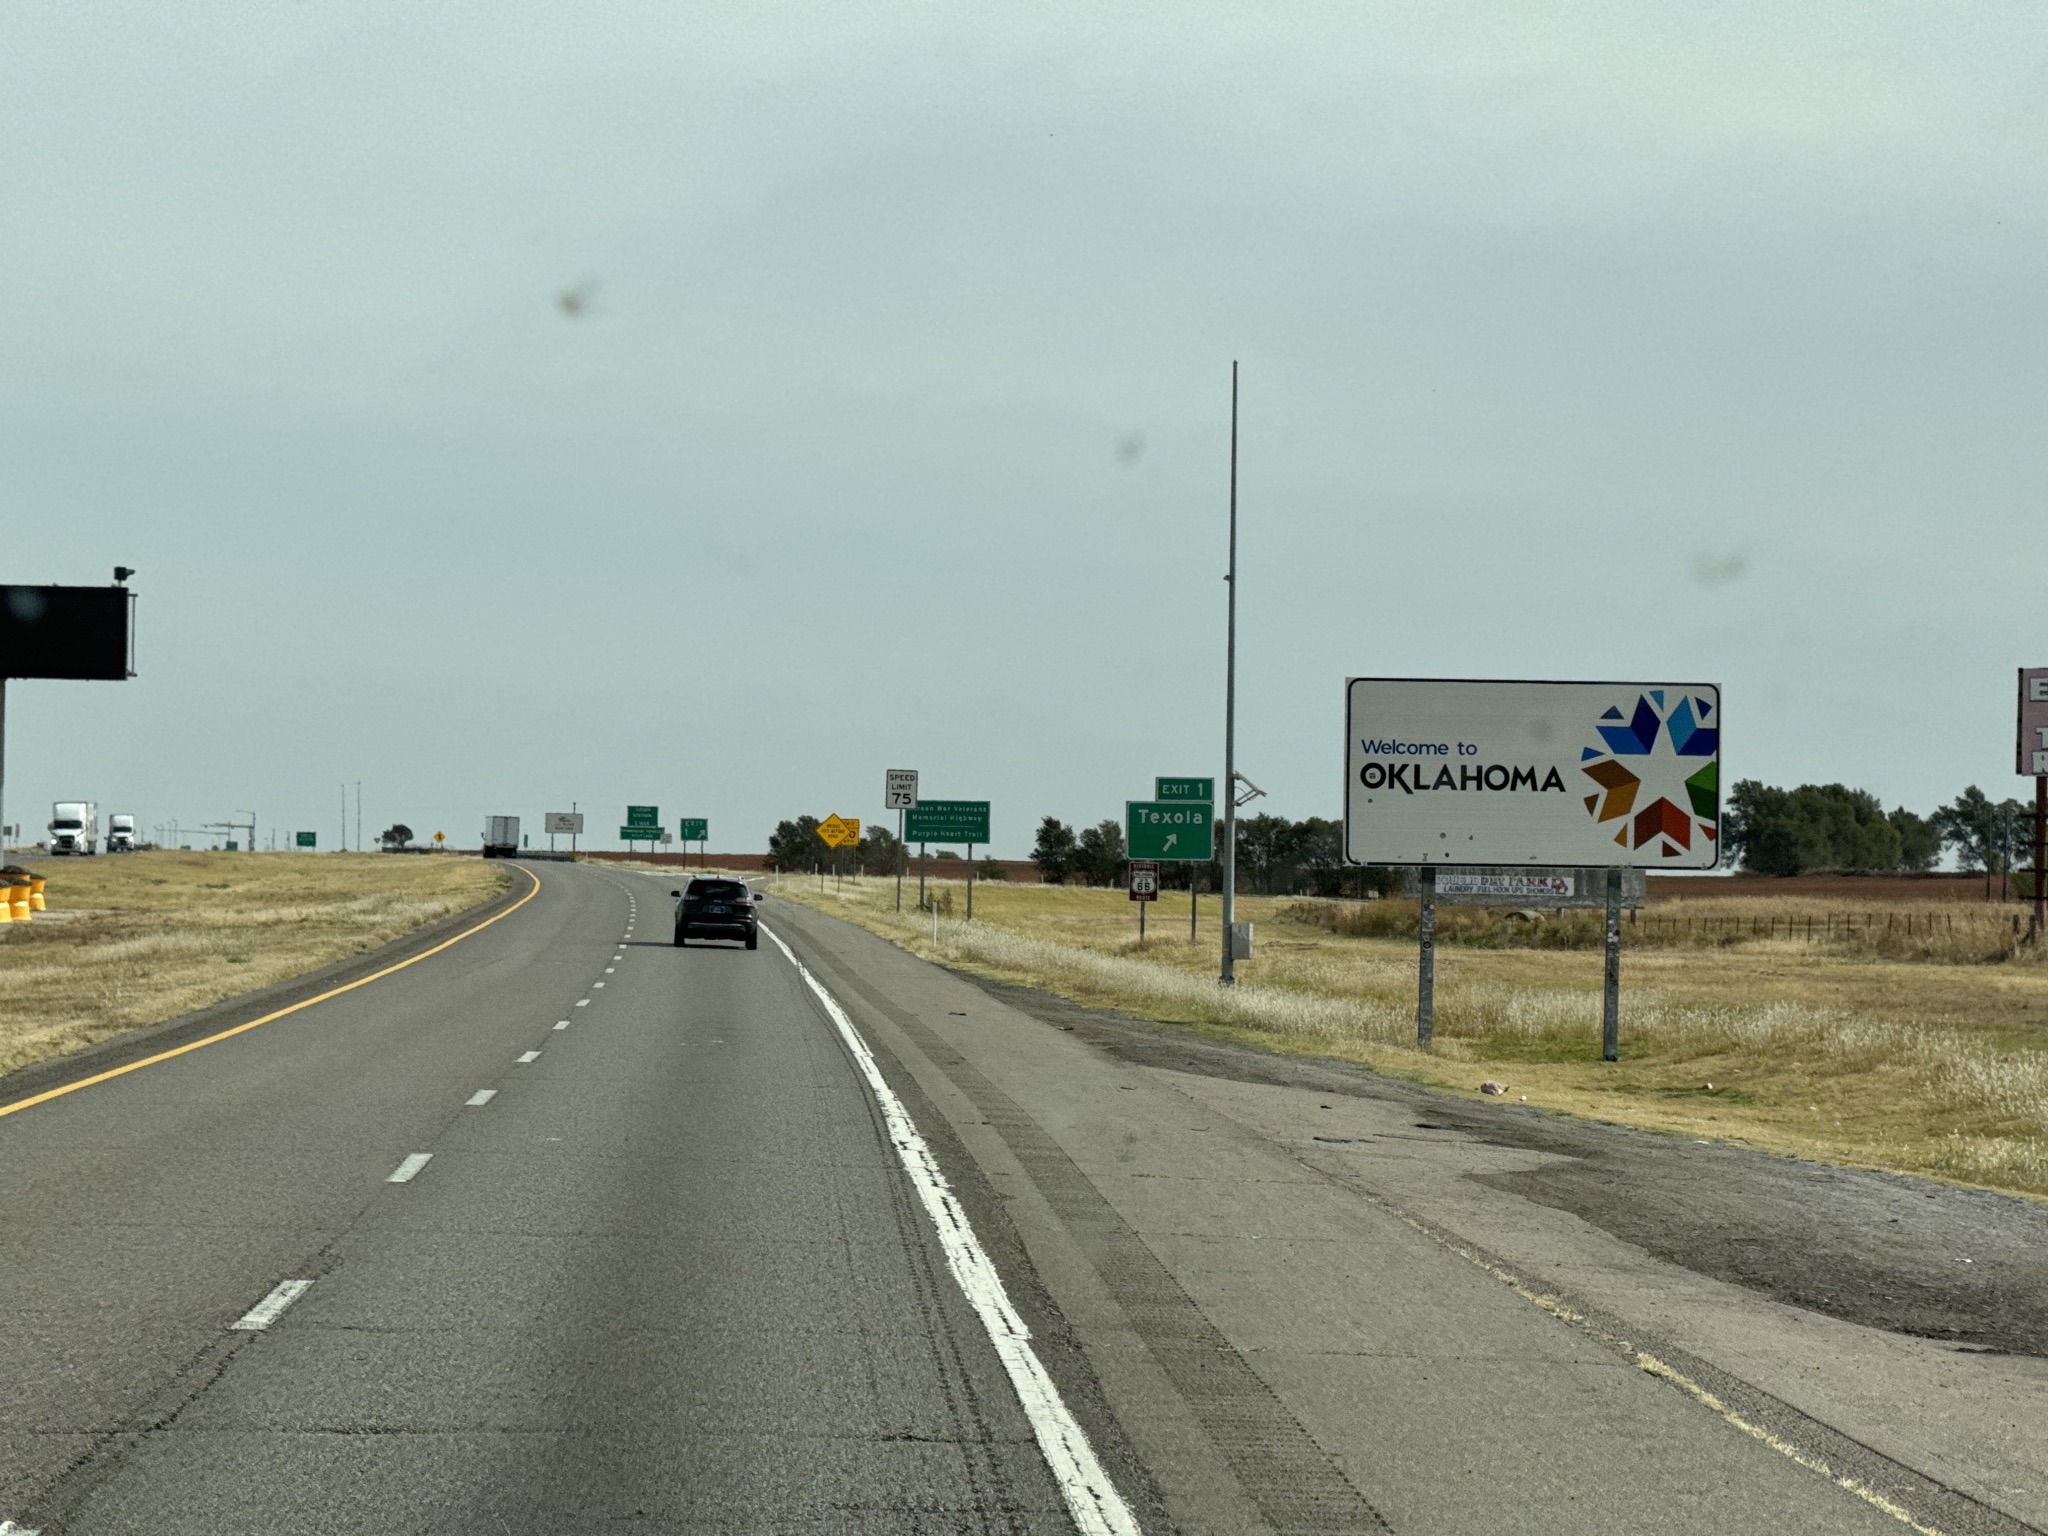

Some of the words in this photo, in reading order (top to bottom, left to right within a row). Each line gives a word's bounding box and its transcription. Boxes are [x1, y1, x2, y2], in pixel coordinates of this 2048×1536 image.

[1361, 739, 1449, 756] Welcome
[1457, 741, 1478, 756] to
[1360, 762, 1567, 795] OKLAHOMA
[1162, 784, 1190, 795] EXIT
[1198, 783, 1203, 797] 1
[892, 793, 912, 805] 75
[954, 805, 987, 813] Veterans
[949, 815, 983, 823] Highway
[1138, 809, 1203, 824] Texola
[912, 830, 938, 838] Purple
[1137, 882, 1150, 891] 66
[1509, 876, 1549, 887] PARK
[1444, 885, 1474, 893] LAUNDRY
[1477, 885, 1493, 894] FULL
[1493, 886, 1511, 894] HOOK
[1511, 886, 1524, 894] UPS
[1526, 887, 1555, 895] SHOWERS
